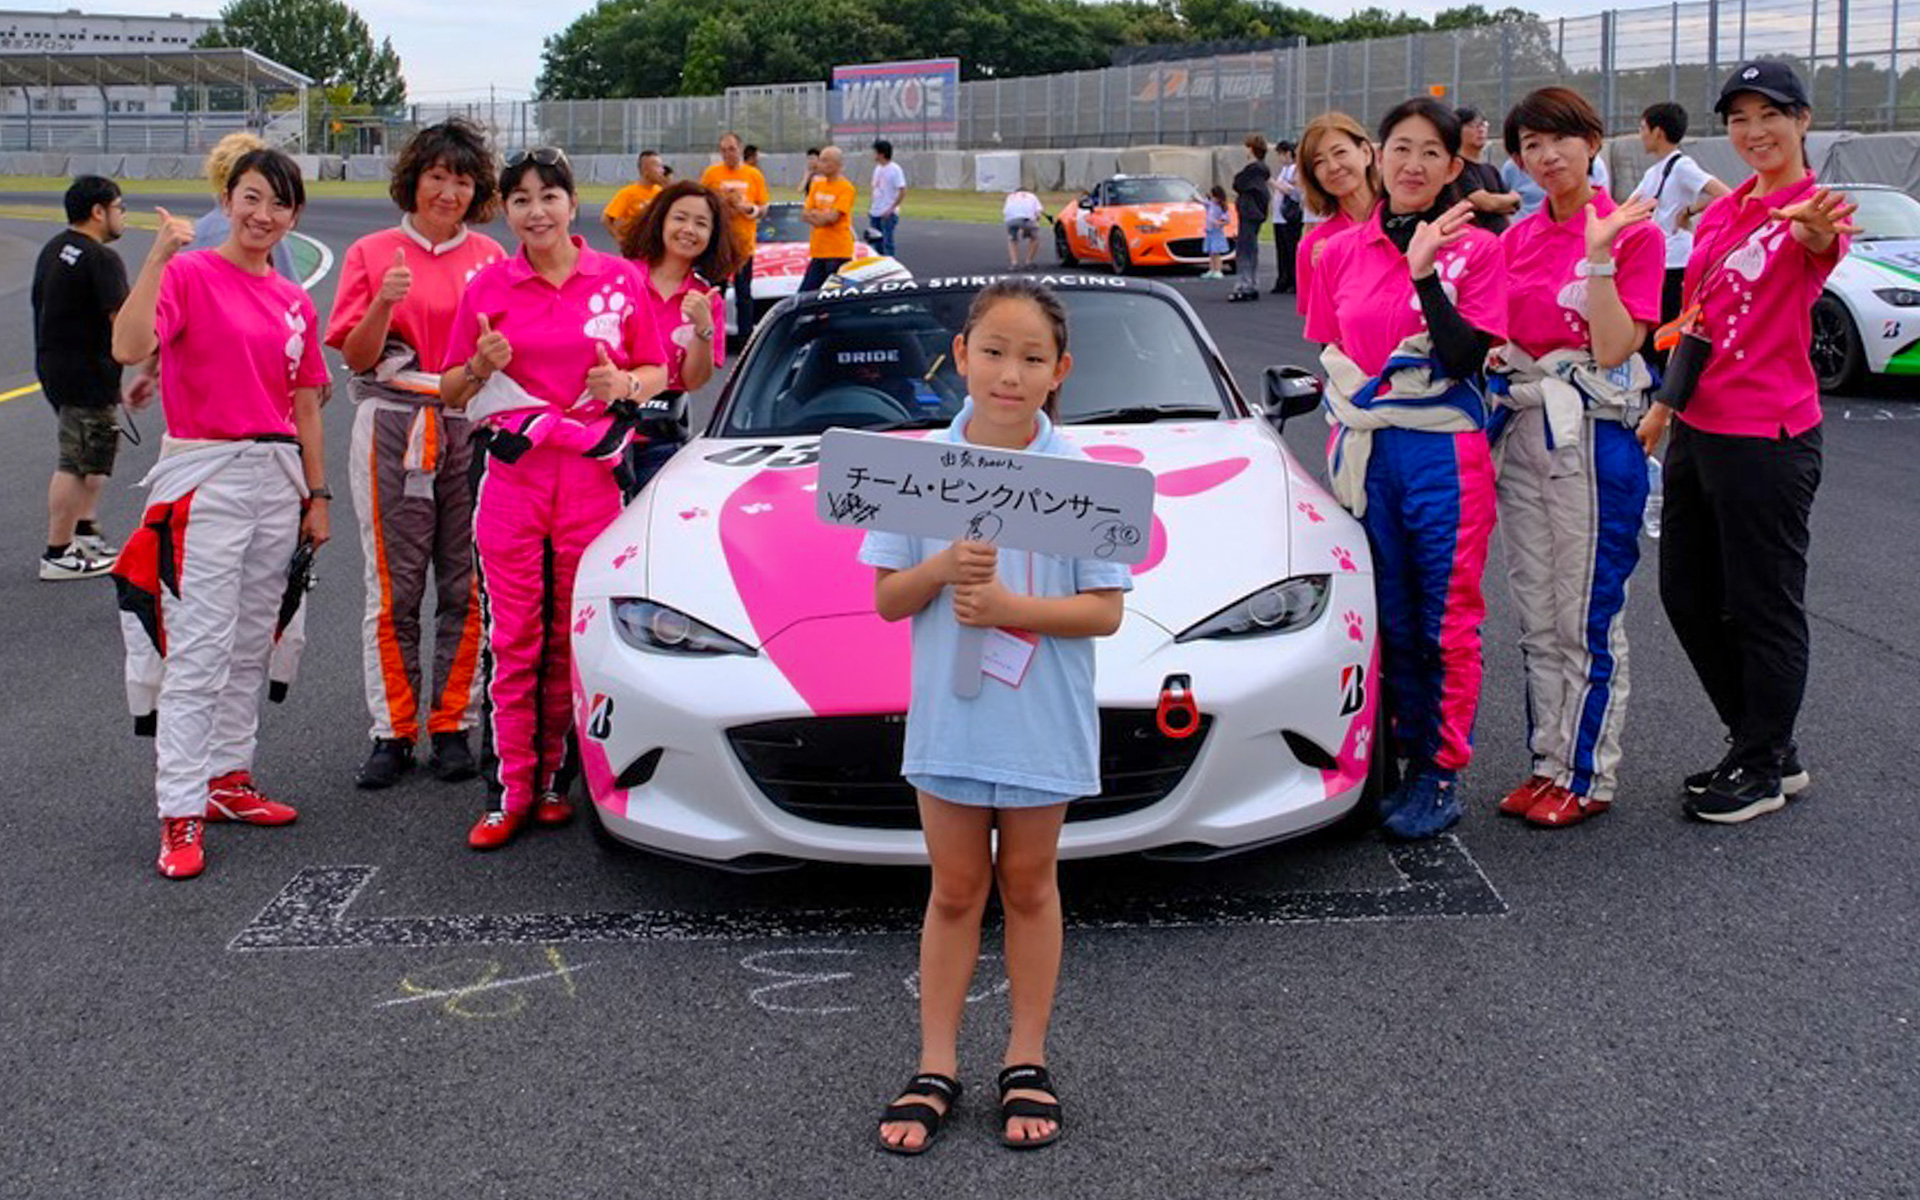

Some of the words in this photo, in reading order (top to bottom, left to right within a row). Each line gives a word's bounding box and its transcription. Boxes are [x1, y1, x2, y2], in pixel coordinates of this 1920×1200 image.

[817, 279, 919, 300] MAZDA
[836, 349, 900, 364] BRIDE
[846, 465, 1121, 520] チーム・ピンクパンサー
